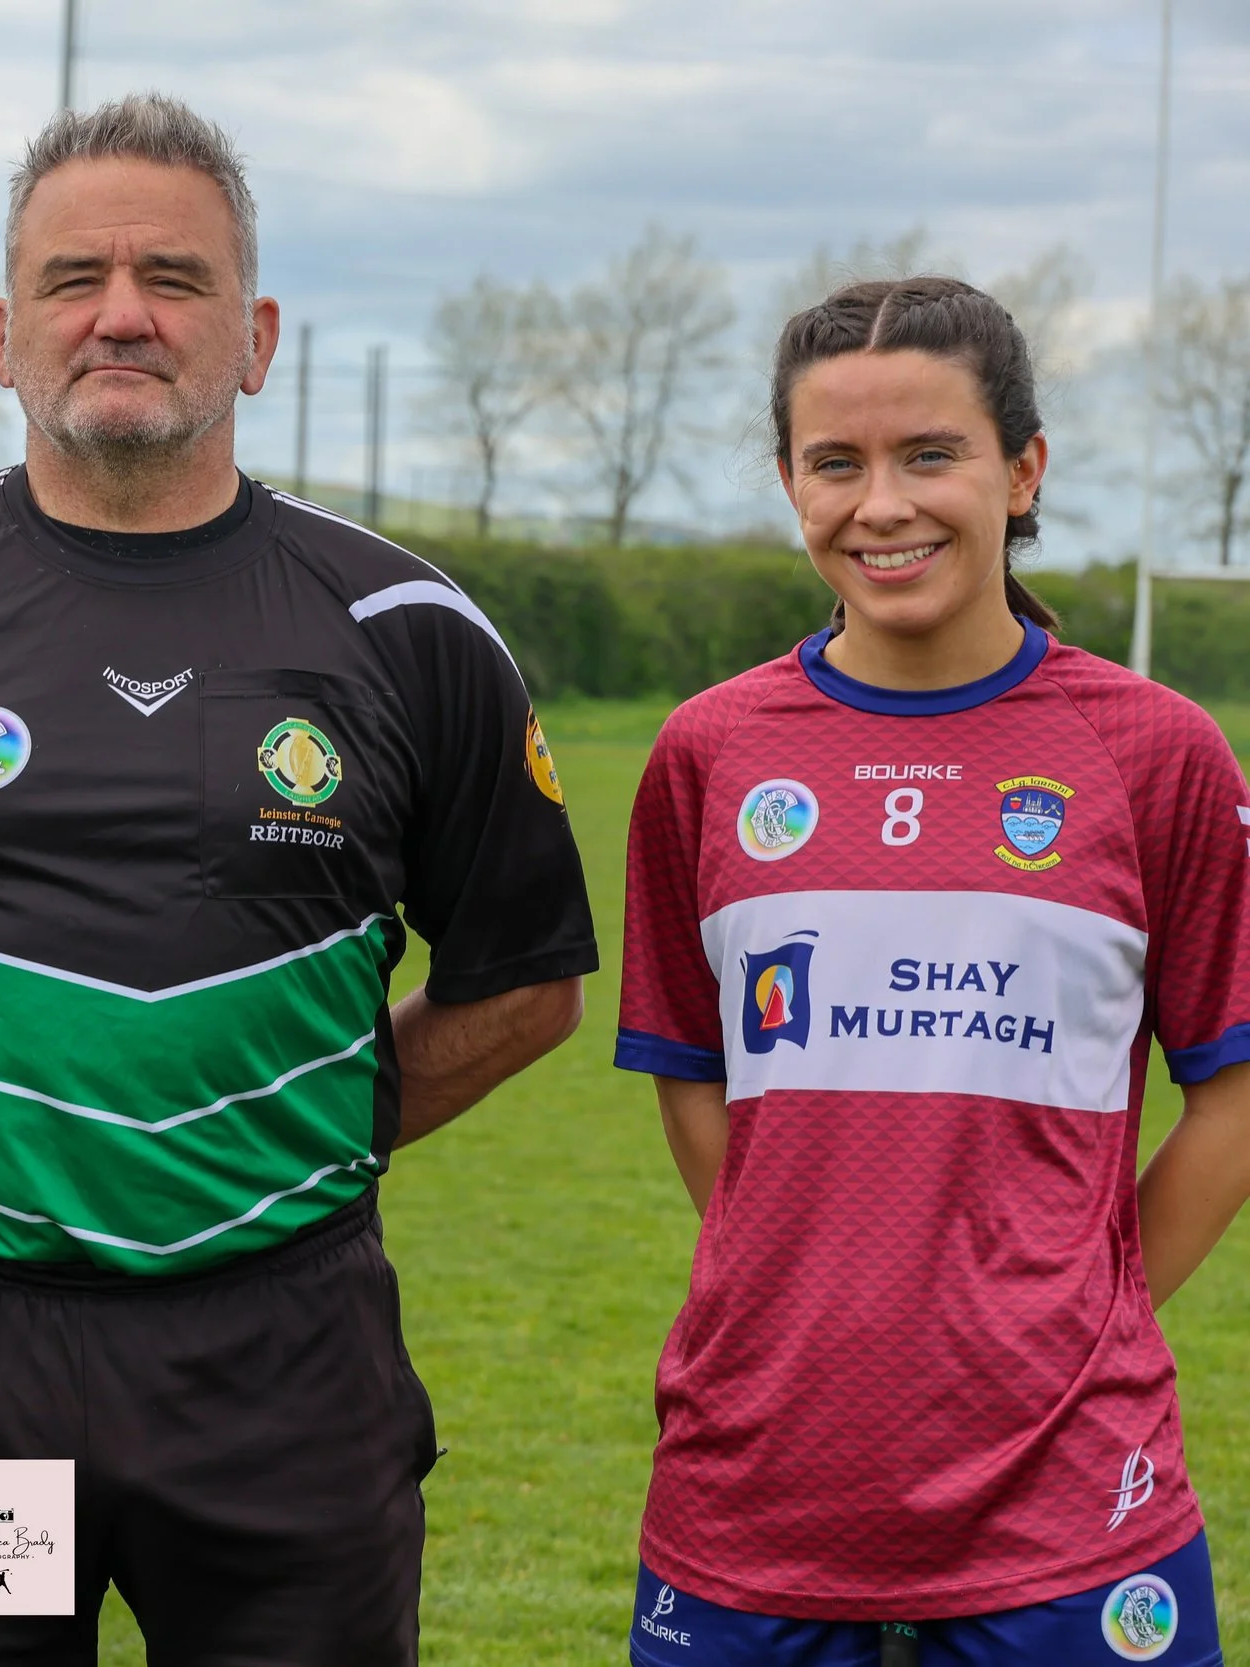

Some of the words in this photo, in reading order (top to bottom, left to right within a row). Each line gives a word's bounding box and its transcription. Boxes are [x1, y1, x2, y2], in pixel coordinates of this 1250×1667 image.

[102, 666, 193, 694] INTOSPORT
[854, 764, 963, 780] BOURKE
[259, 807, 302, 821] Leinster
[304, 811, 342, 828] Camogie
[881, 787, 924, 846] 8
[249, 821, 345, 850] RÉITEOIR
[889, 958, 1020, 997] SHAY
[829, 1005, 1055, 1054] MURTAGH
[640, 1614, 691, 1647] BOURKE
